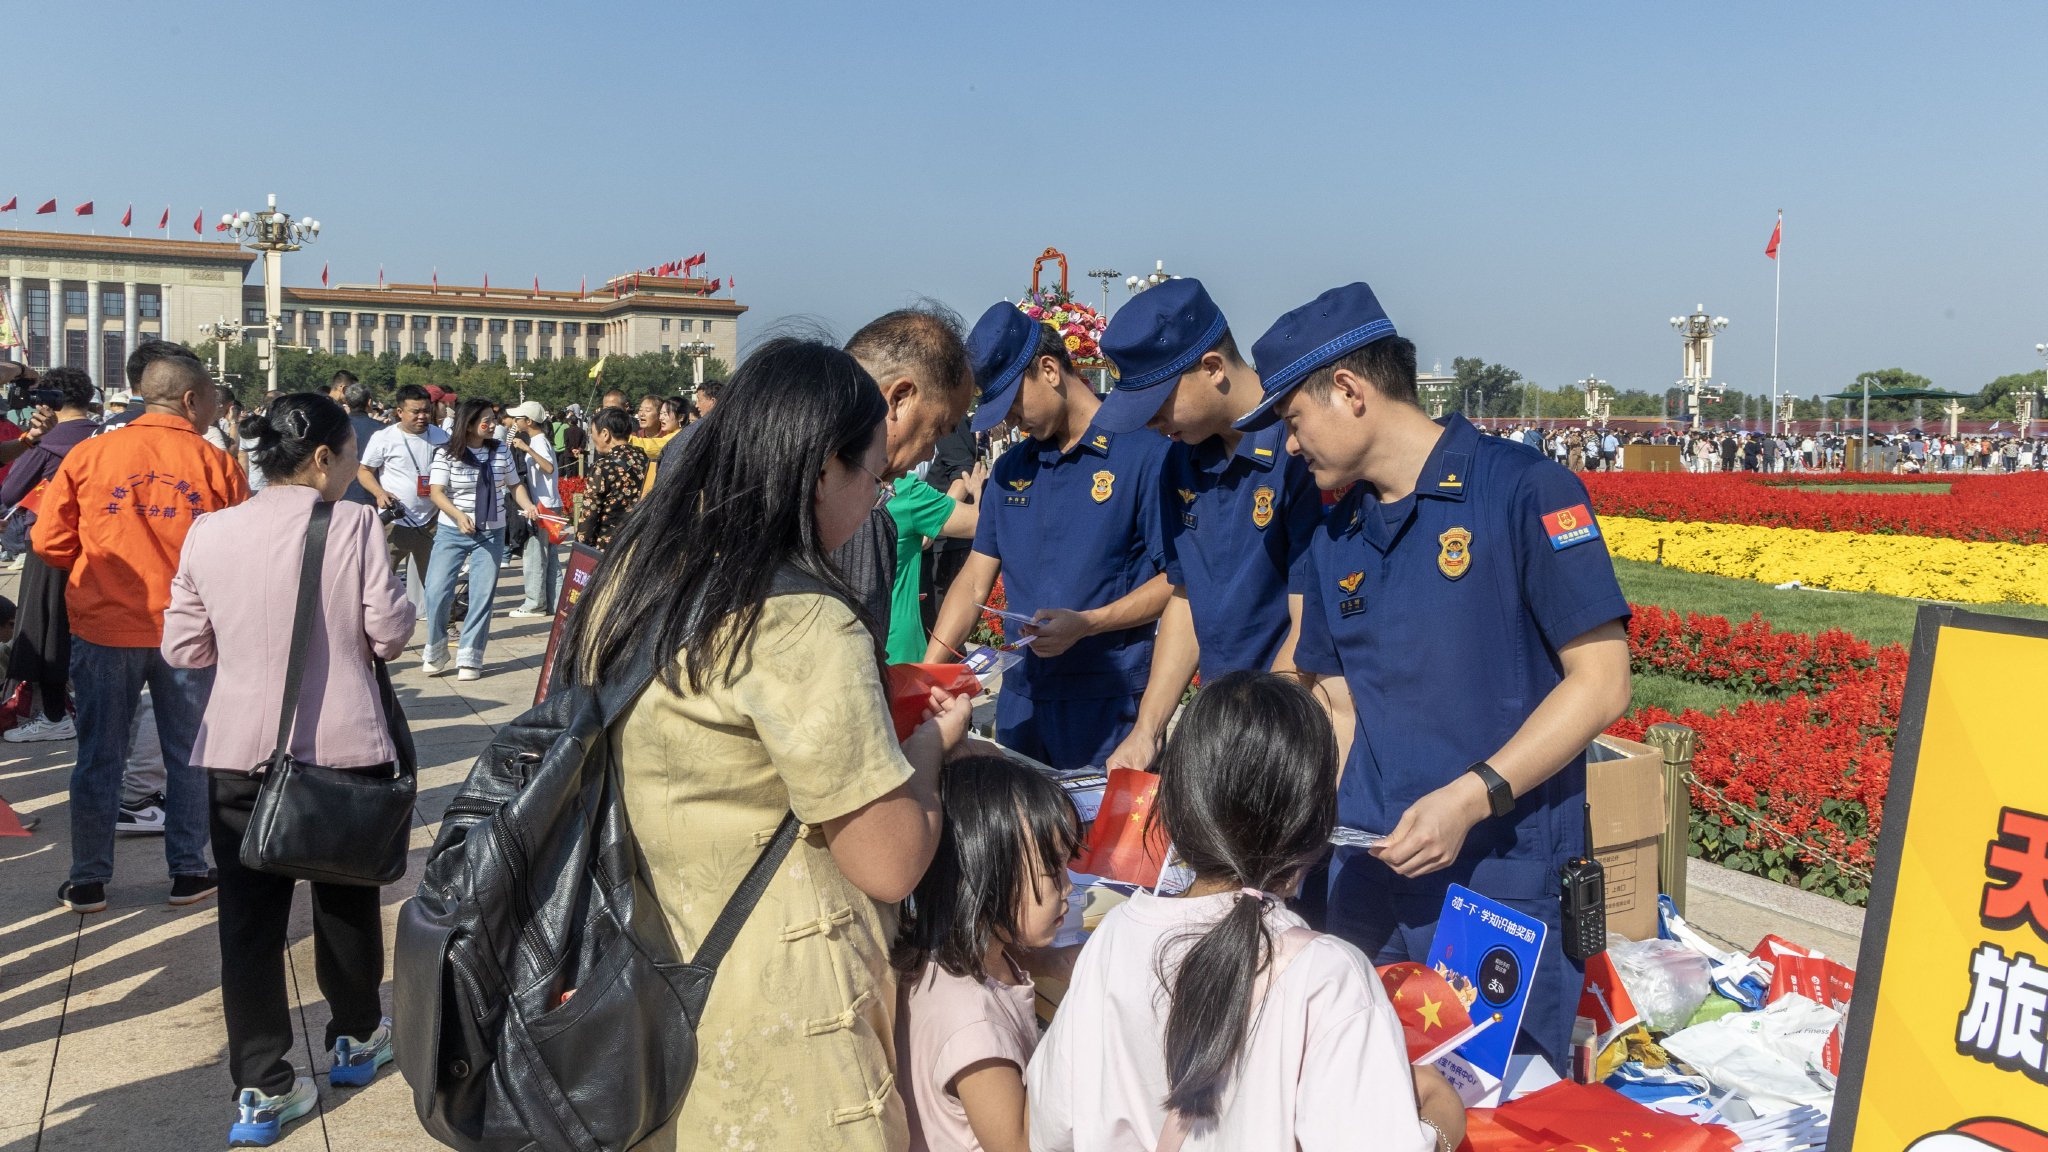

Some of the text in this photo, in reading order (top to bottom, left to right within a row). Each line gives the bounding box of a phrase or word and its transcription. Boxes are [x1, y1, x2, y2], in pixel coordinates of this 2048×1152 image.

[1451, 896, 1536, 944] 碰一下·学知识抽奖励
